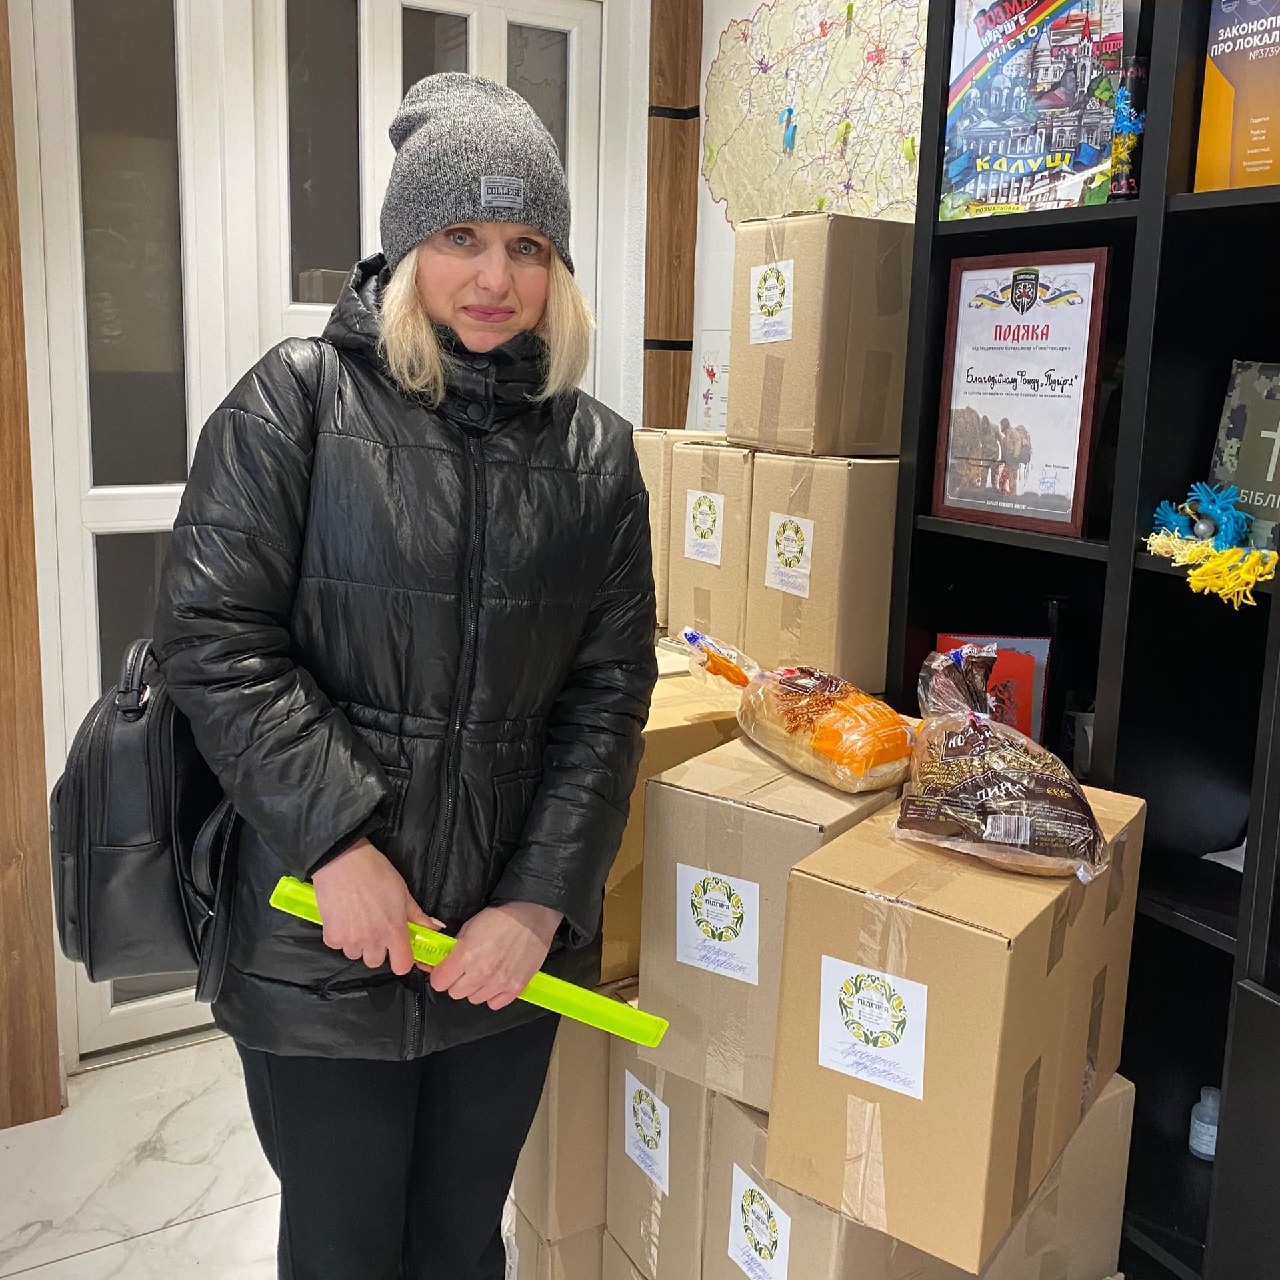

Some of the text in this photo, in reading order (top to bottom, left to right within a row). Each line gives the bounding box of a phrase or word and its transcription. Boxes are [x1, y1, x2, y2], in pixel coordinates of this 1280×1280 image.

[980, 14, 1027, 49] НАШЕ
[986, 25, 1040, 63] МІСТО
[1210, 40, 1233, 58] ПРО
[976, 152, 1072, 174] КАЛУШ
[993, 324, 1050, 343] ПОДЯКА
